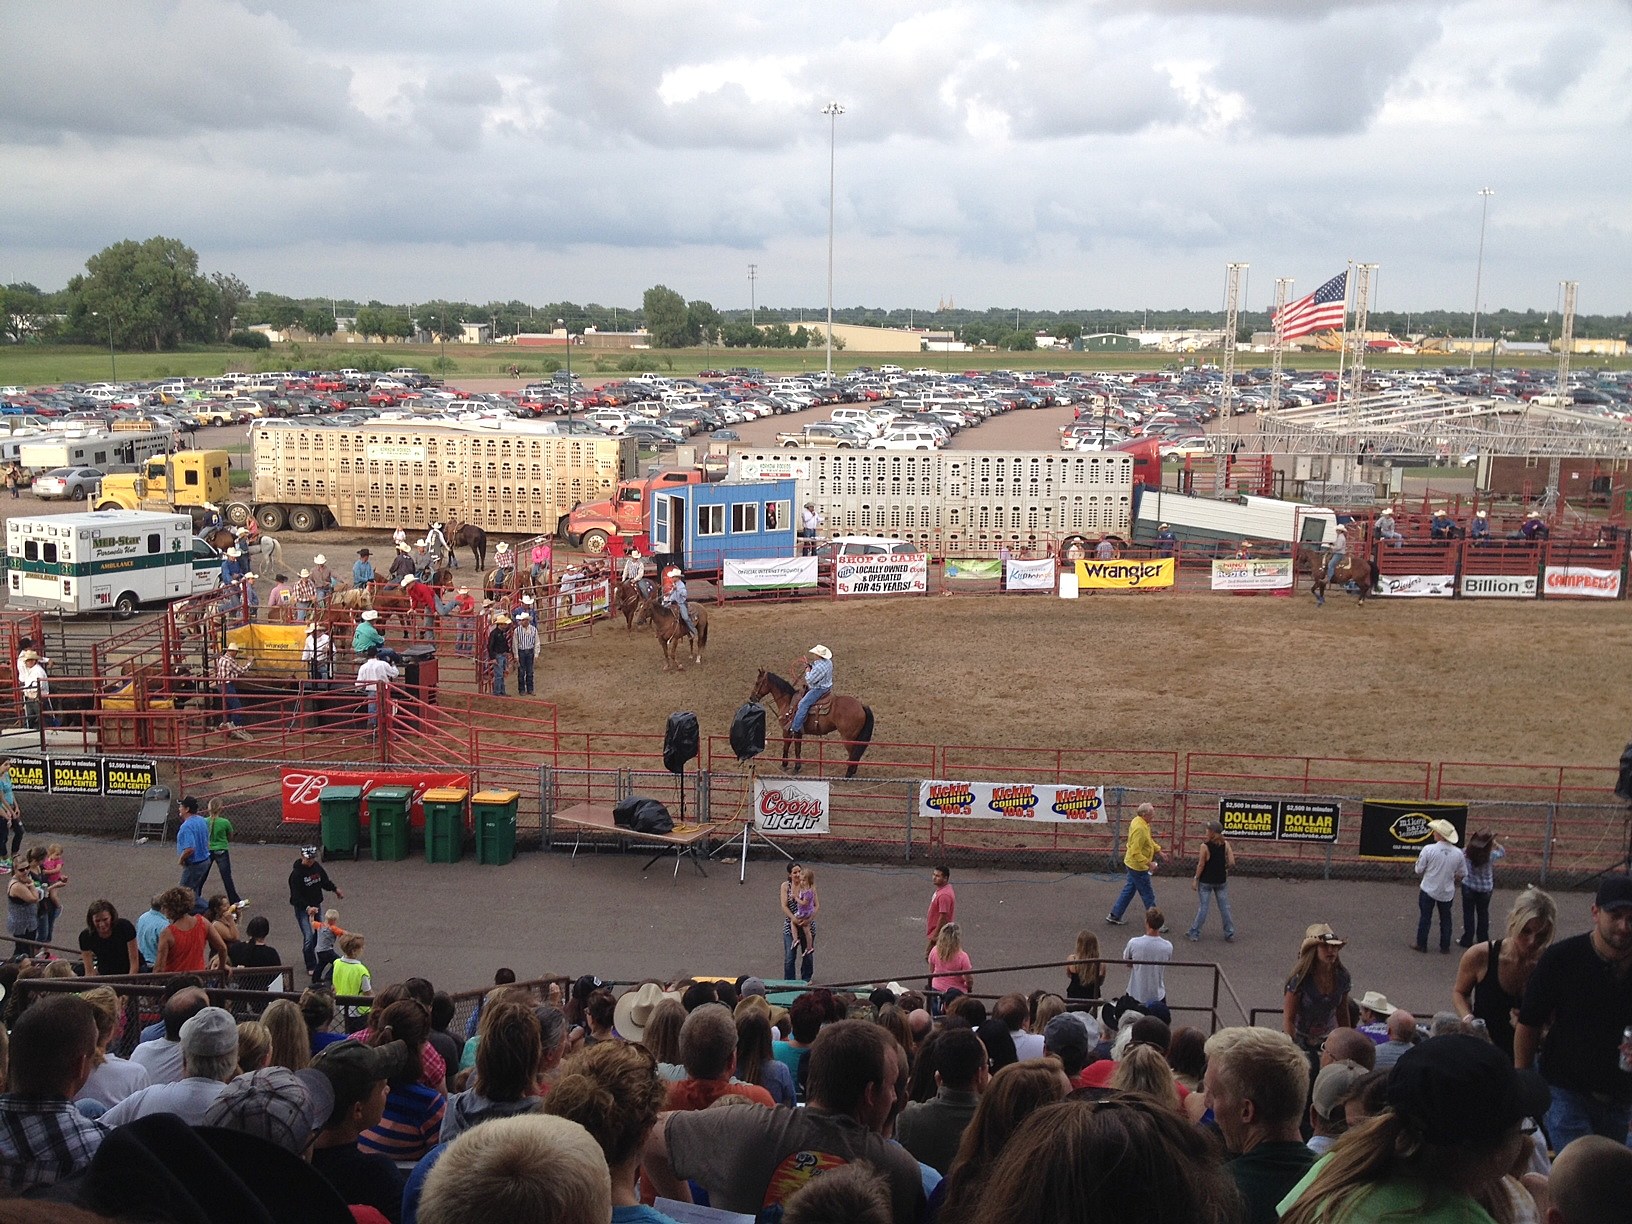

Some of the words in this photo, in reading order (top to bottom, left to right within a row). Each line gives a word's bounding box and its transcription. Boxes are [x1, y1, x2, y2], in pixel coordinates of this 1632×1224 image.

[96, 548, 123, 557] Paramedic
[101, 561, 134, 569] AMBULANCE
[856, 565, 884, 574] LOCALLY
[1084, 562, 1163, 585] Wrangler
[854, 583, 869, 592] FOR
[870, 582, 882, 591] 45
[883, 581, 911, 591] YEARS!
[1466, 579, 1519, 592] Billion
[101, 593, 110, 604] 911
[9, 767, 43, 778] OLLAR
[55, 769, 97, 780] DOLLAR
[109, 772, 151, 783] DOLLAR
[930, 783, 971, 798] Kickin'
[992, 785, 1034, 800] Kickin'
[1056, 787, 1098, 803] Kickin'
[761, 789, 823, 818] Coors
[930, 794, 971, 806] country
[992, 797, 1034, 808] country
[1056, 799, 1098, 811] country
[941, 804, 971, 815] 100.5
[1003, 806, 1034, 818] 100.5
[1066, 809, 1098, 820] 100.5
[762, 814, 820, 829] LIGHT
[1225, 812, 1271, 824] DOLLAR
[1285, 814, 1332, 827] DOLLAR
